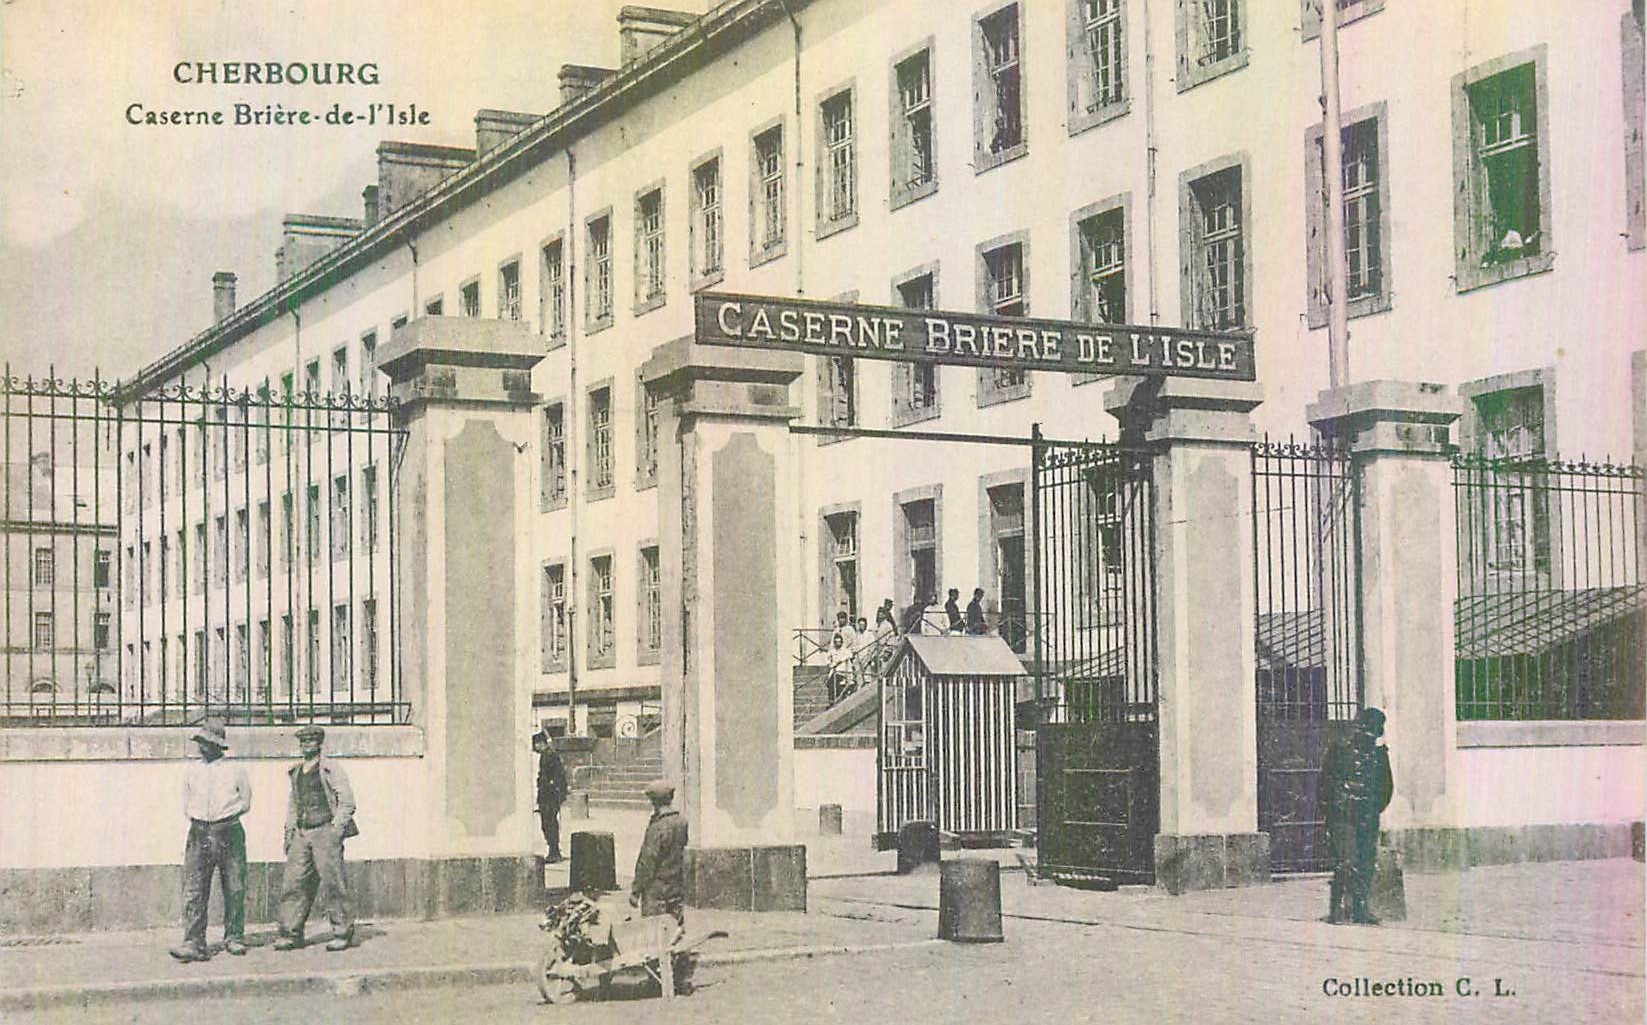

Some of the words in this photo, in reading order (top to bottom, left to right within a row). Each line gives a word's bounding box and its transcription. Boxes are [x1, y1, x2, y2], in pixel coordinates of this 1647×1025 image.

[717, 302, 904, 350] CASERNE
[925, 318, 1062, 361] BRIERE
[1077, 334, 1115, 364] DE
[1130, 333, 1238, 371] L'ISLE
